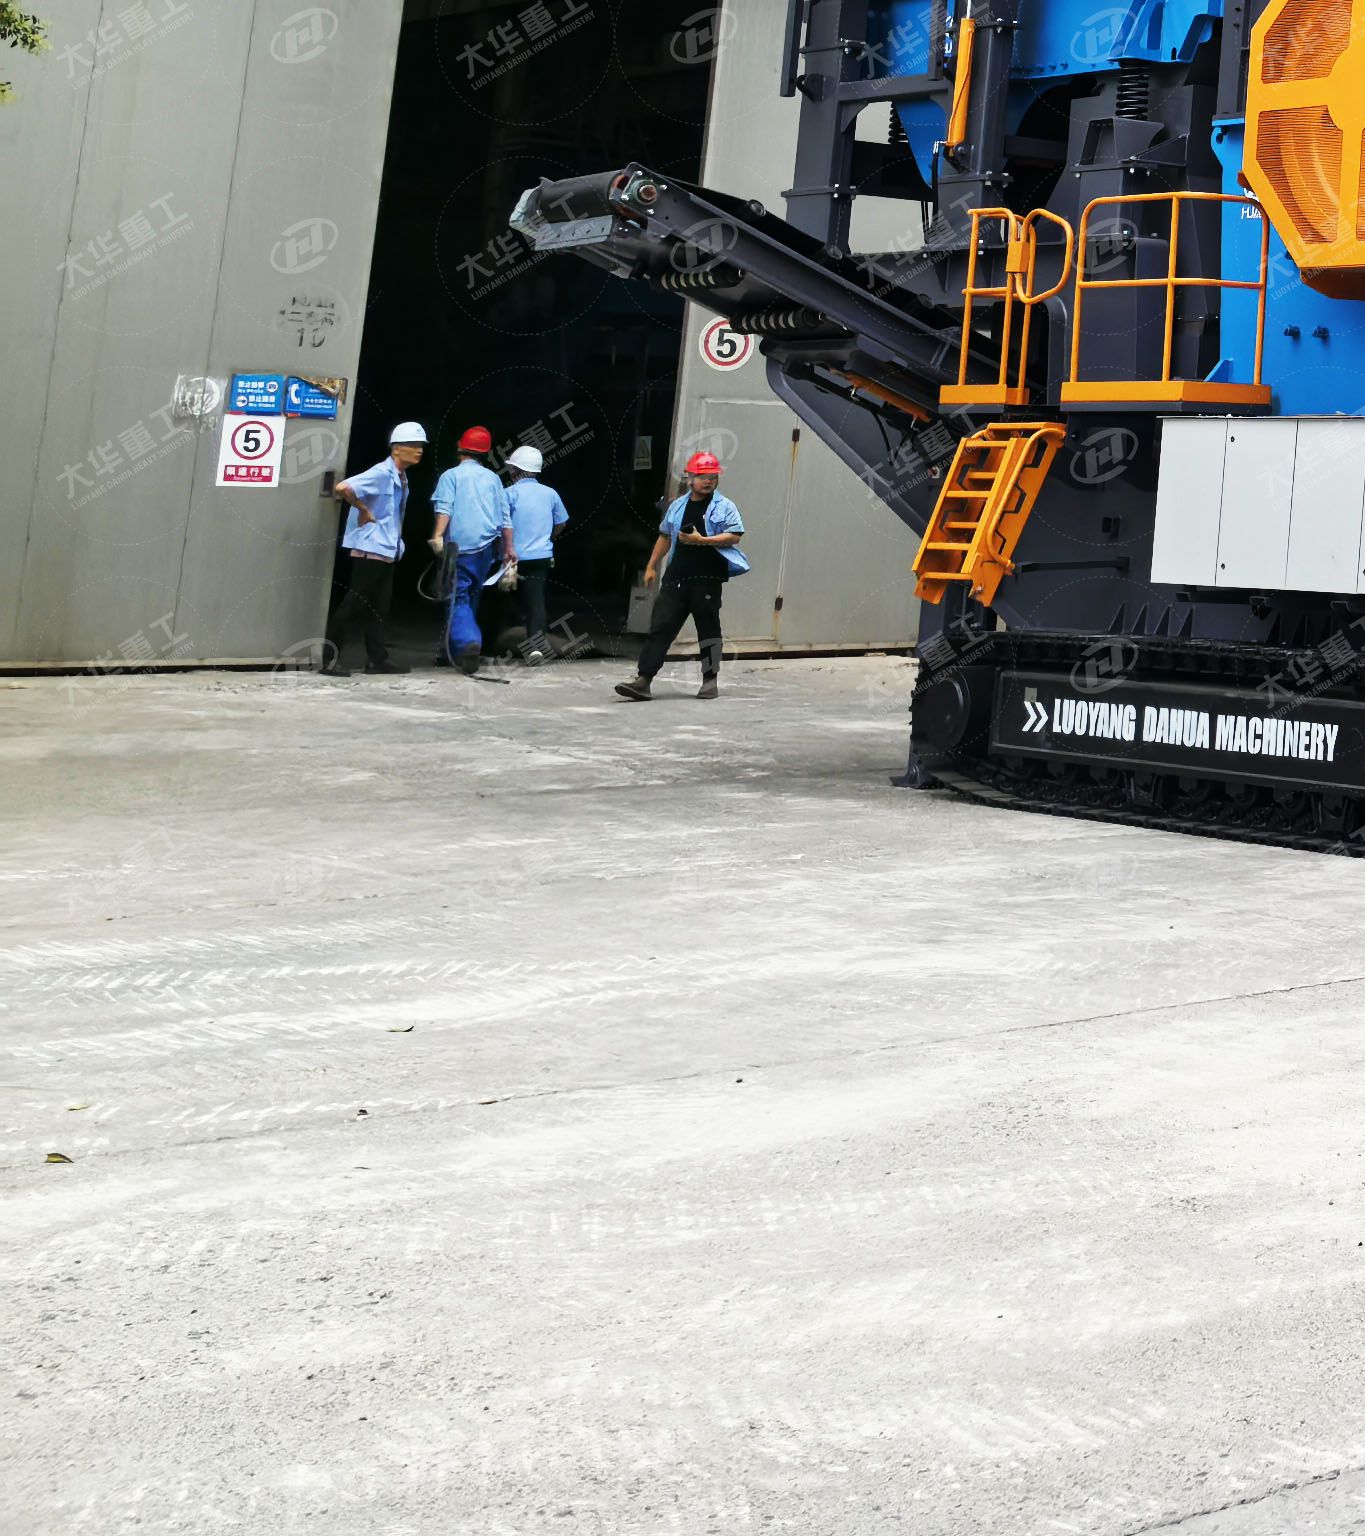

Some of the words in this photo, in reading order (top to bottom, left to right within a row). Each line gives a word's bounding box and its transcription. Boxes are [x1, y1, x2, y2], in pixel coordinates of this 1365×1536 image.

[716, 328, 737, 358] 5
[243, 429, 261, 453] 5
[1052, 698, 1137, 741] LUOYANG
[1142, 705, 1210, 749] DAHUA
[1214, 714, 1339, 762] MACHINERY
